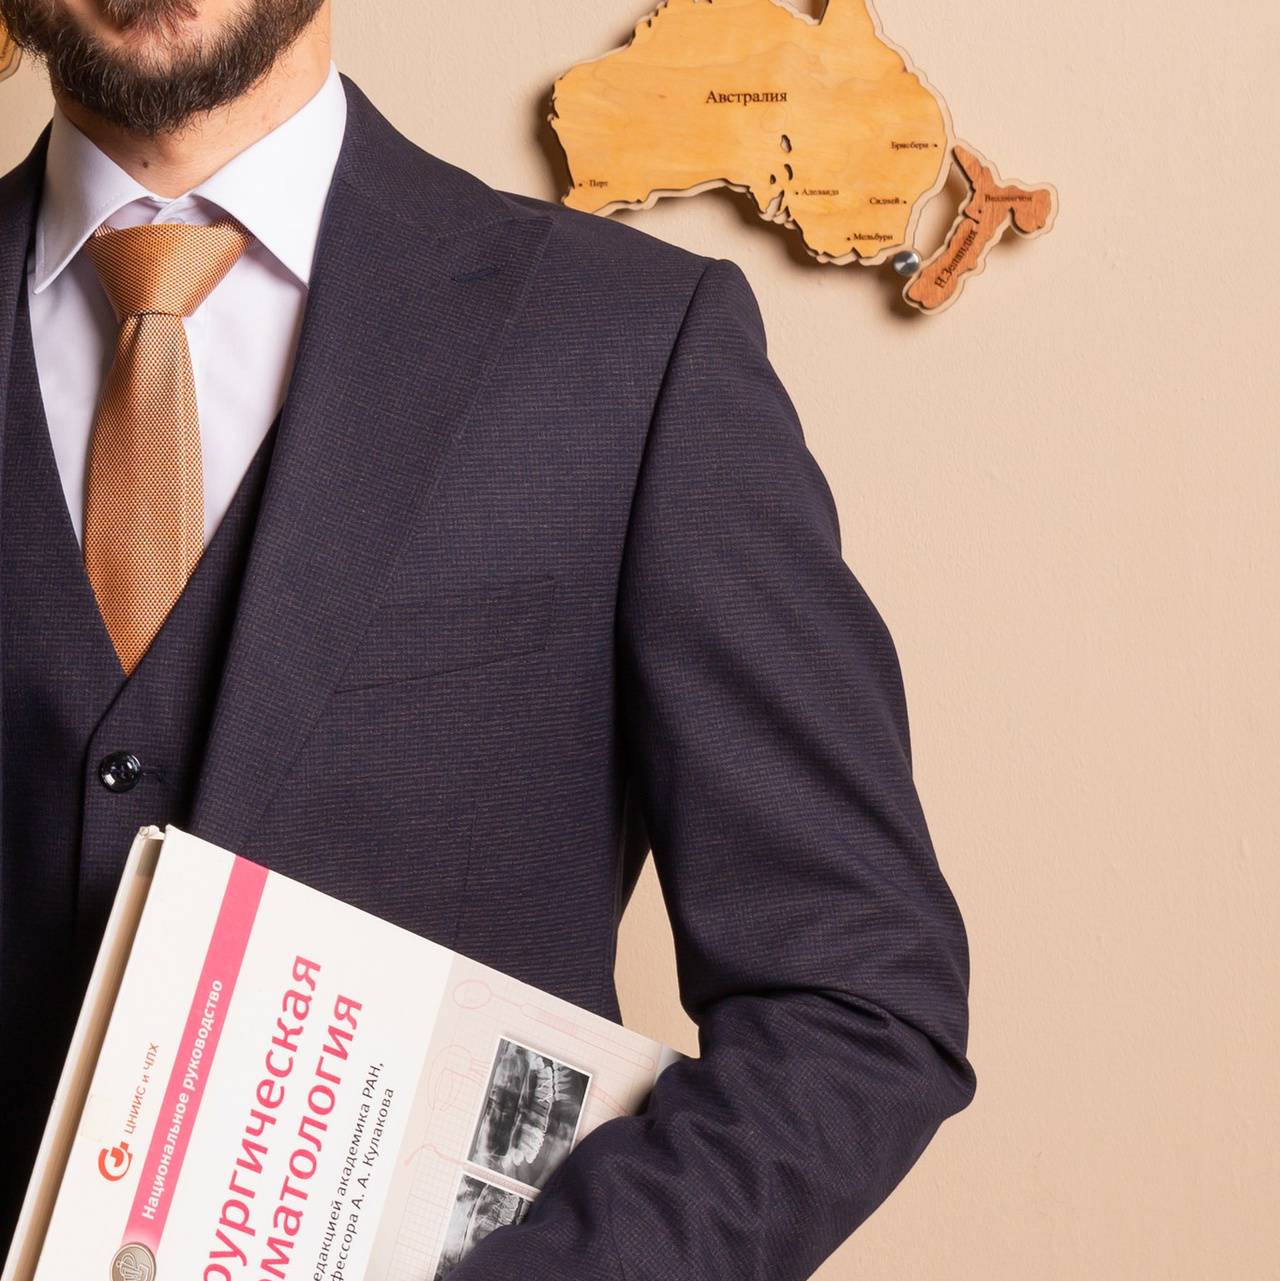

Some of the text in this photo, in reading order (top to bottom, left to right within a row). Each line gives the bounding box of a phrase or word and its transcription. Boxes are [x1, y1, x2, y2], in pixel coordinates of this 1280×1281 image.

[705, 90, 788, 107] Австралия
[589, 179, 609, 188] Перт
[869, 197, 899, 207] Сидней
[853, 233, 894, 242] Мельбурн
[124, 1042, 160, 1135] ЦНИИС и ЧЛХ
[142, 980, 223, 1220] Национальное руководство
[340, 1102, 371, 1196] академика
[362, 1061, 385, 1100] РАН,
[362, 1087, 395, 1169] Кулакова
[360, 1172, 372, 1190] А.
[354, 1193, 366, 1211] А.
